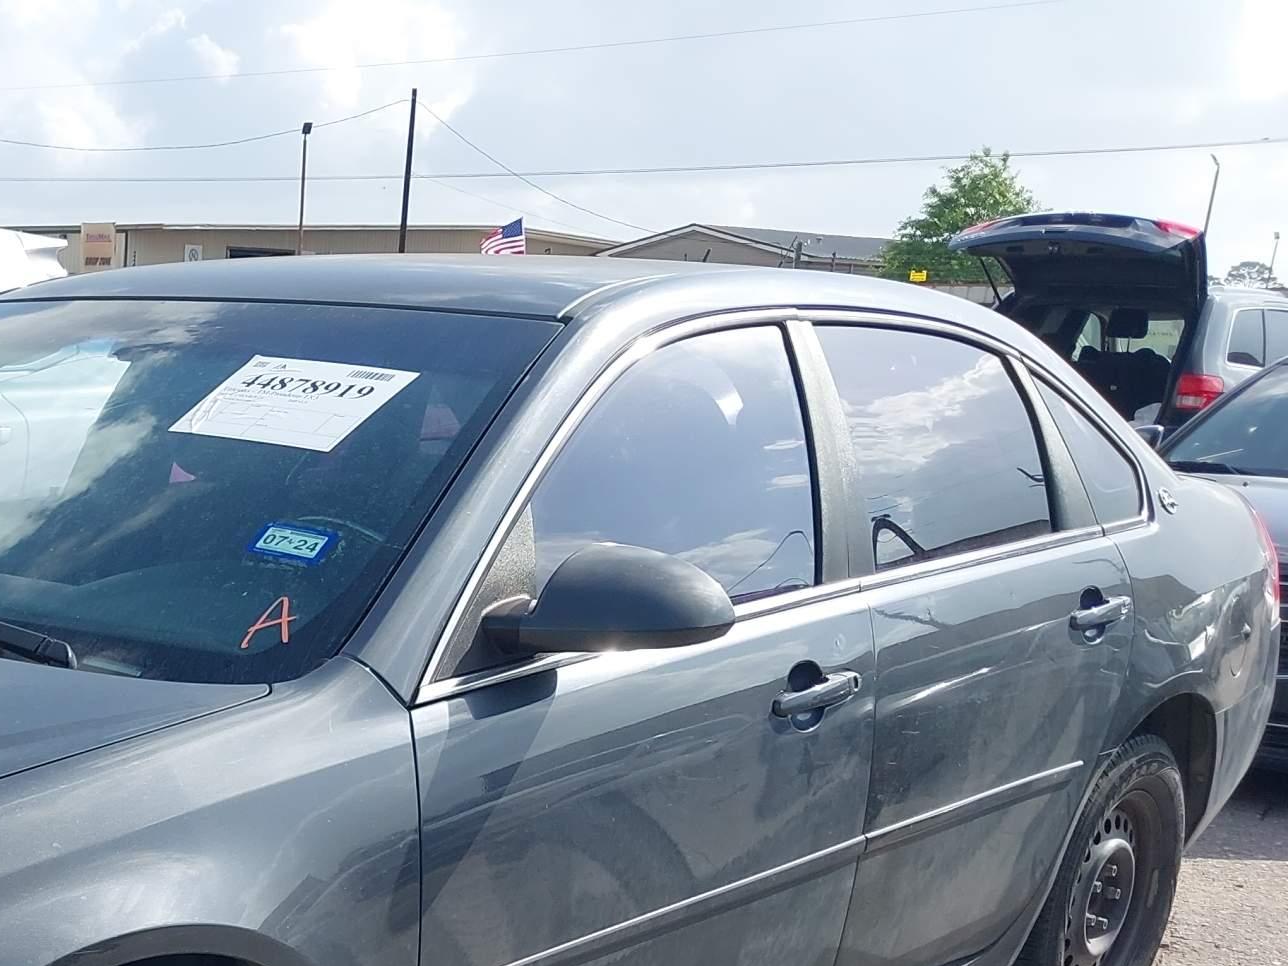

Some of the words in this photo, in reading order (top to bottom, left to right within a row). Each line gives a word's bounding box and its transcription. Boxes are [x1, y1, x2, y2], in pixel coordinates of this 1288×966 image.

[240, 372, 375, 400] 44878919
[293, 539, 320, 553] 24
[240, 596, 297, 649] A
